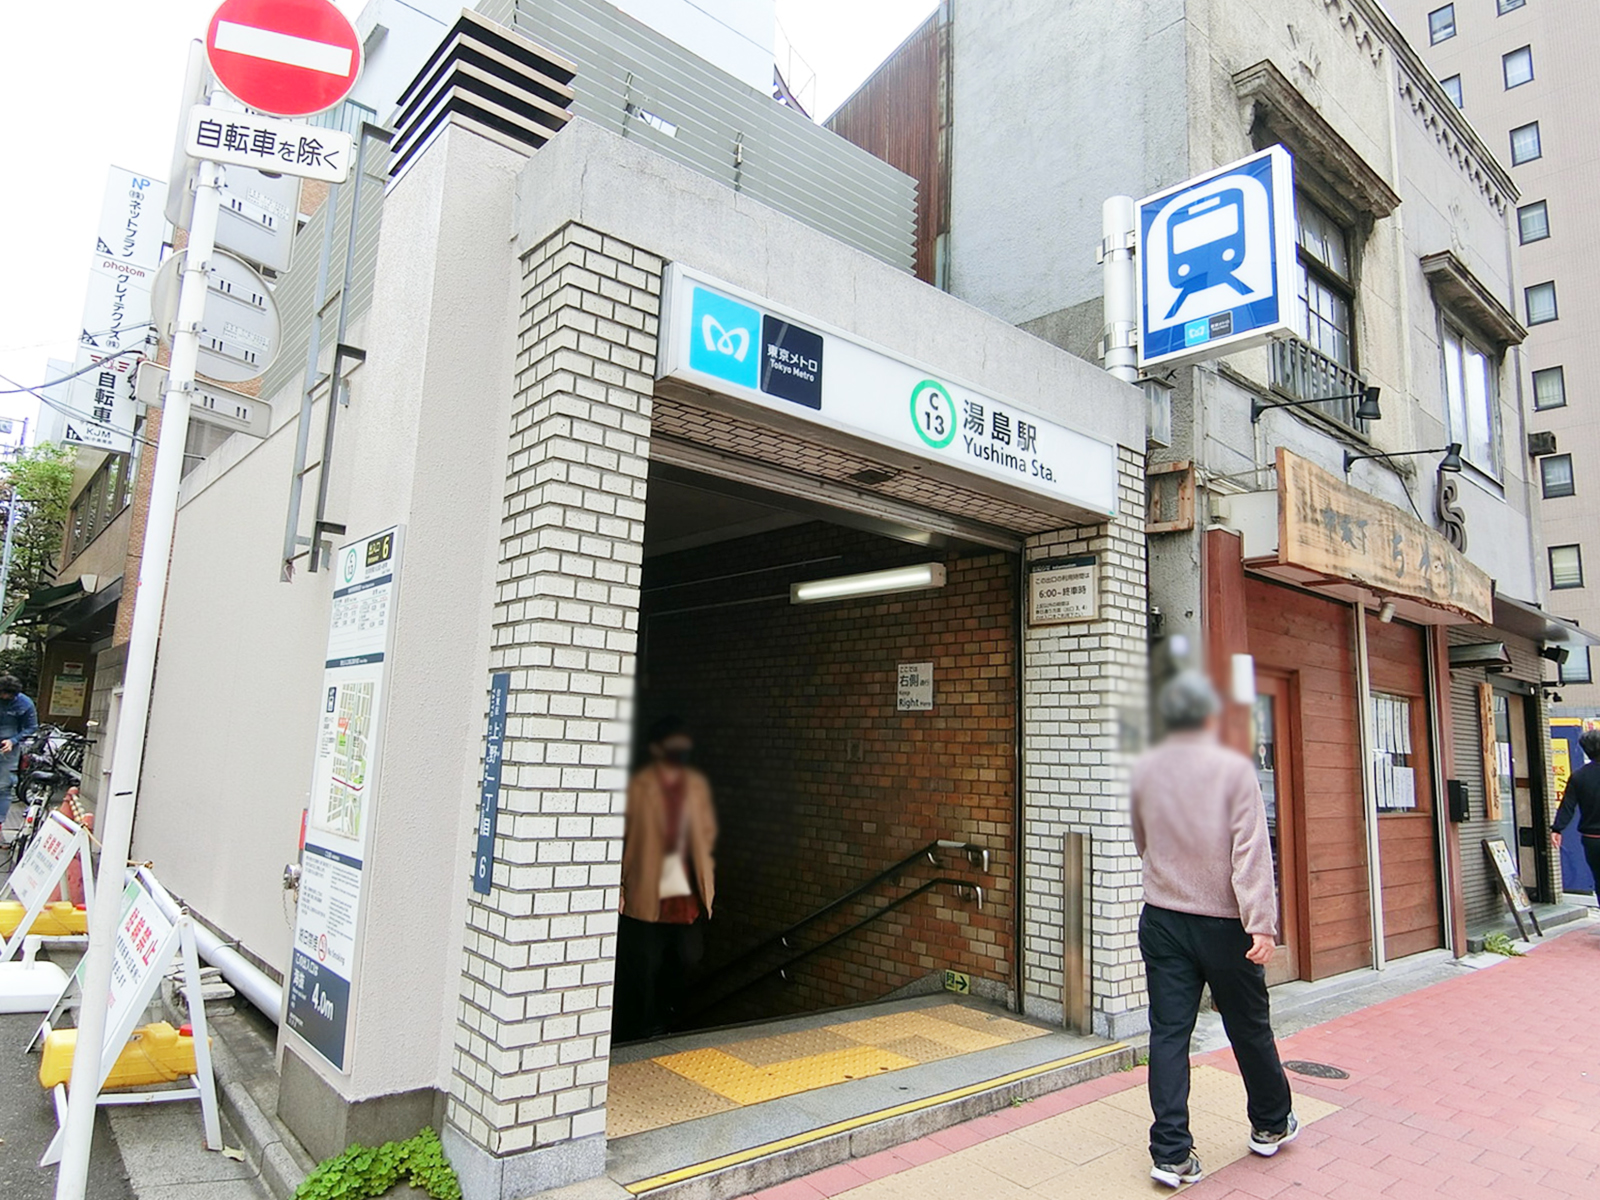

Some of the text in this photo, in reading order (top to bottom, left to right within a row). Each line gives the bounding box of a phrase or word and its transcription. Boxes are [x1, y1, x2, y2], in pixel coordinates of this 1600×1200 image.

[196, 119, 340, 170] 自転車を除く
[103, 260, 145, 278] photom
[767, 343, 818, 373] 東京メトロ
[769, 358, 815, 382] Tokyo Metro
[93, 371, 116, 423] 自転車
[929, 392, 940, 411] C
[86, 427, 111, 439] KJM
[924, 411, 945, 436] 13
[962, 399, 1037, 454] 湯島駅
[963, 434, 1057, 483] Yushima Sta.
[382, 536, 390, 559] 6
[479, 855, 486, 878] 6
[311, 982, 334, 1021] 4.0m
